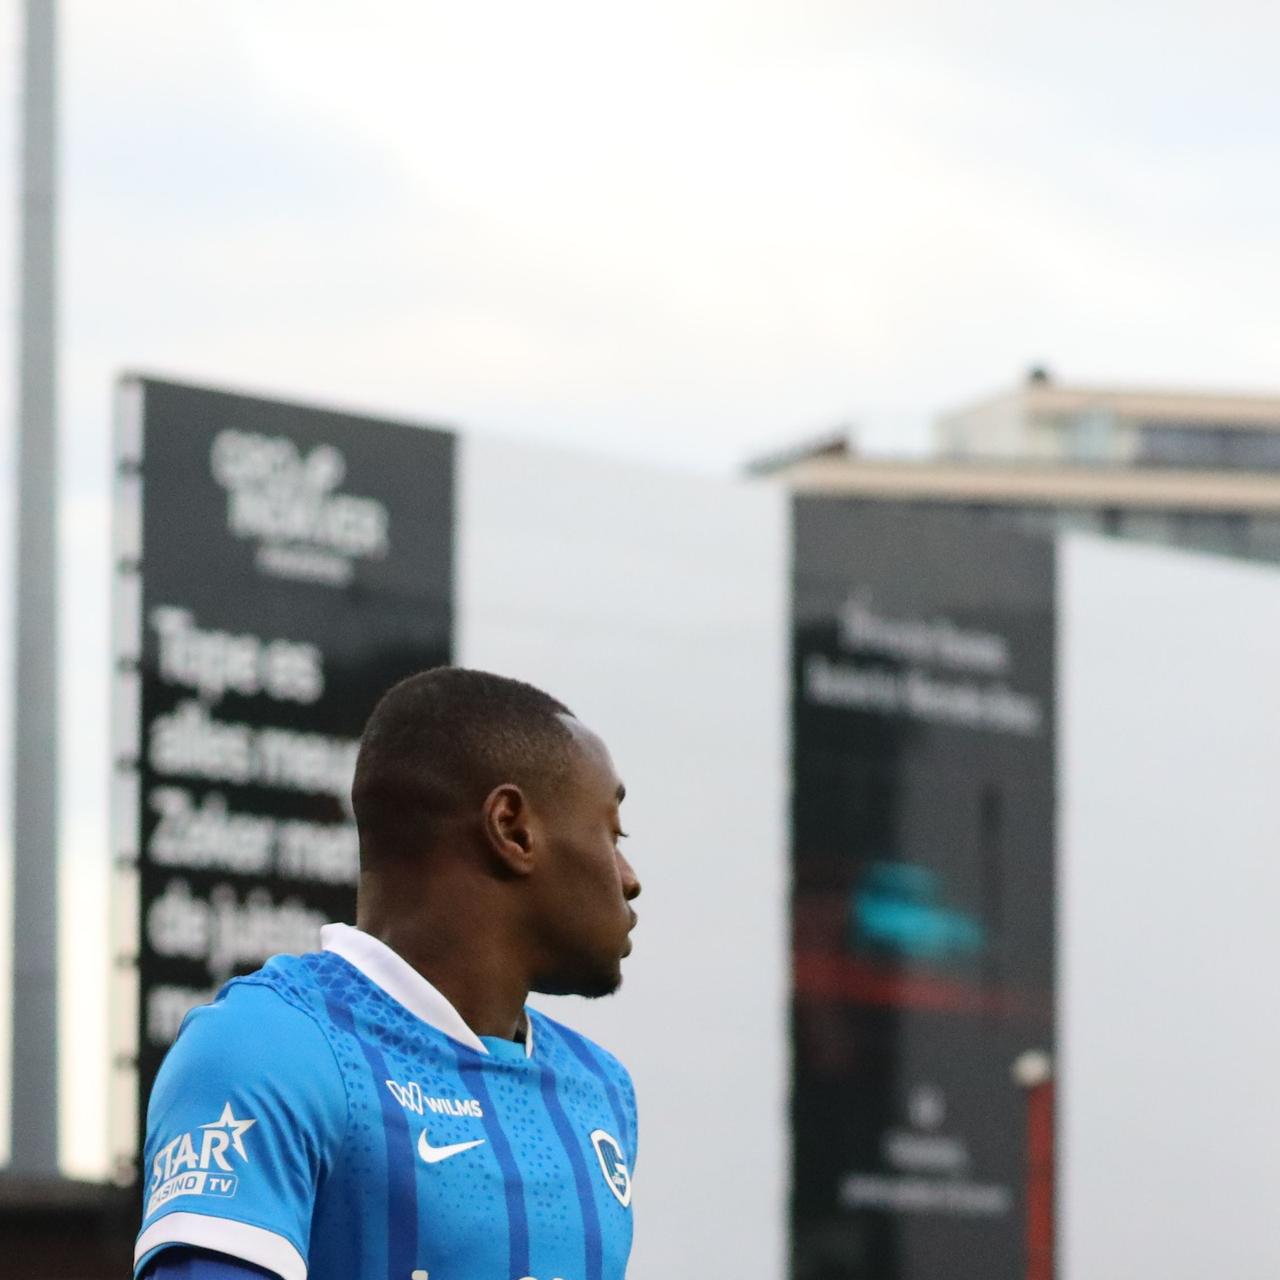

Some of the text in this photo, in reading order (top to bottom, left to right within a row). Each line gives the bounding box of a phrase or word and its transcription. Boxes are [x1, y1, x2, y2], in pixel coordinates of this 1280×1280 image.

[423, 1096, 483, 1118] WILMS
[153, 1129, 234, 1192] STAR
[210, 1178, 233, 1192] TV
